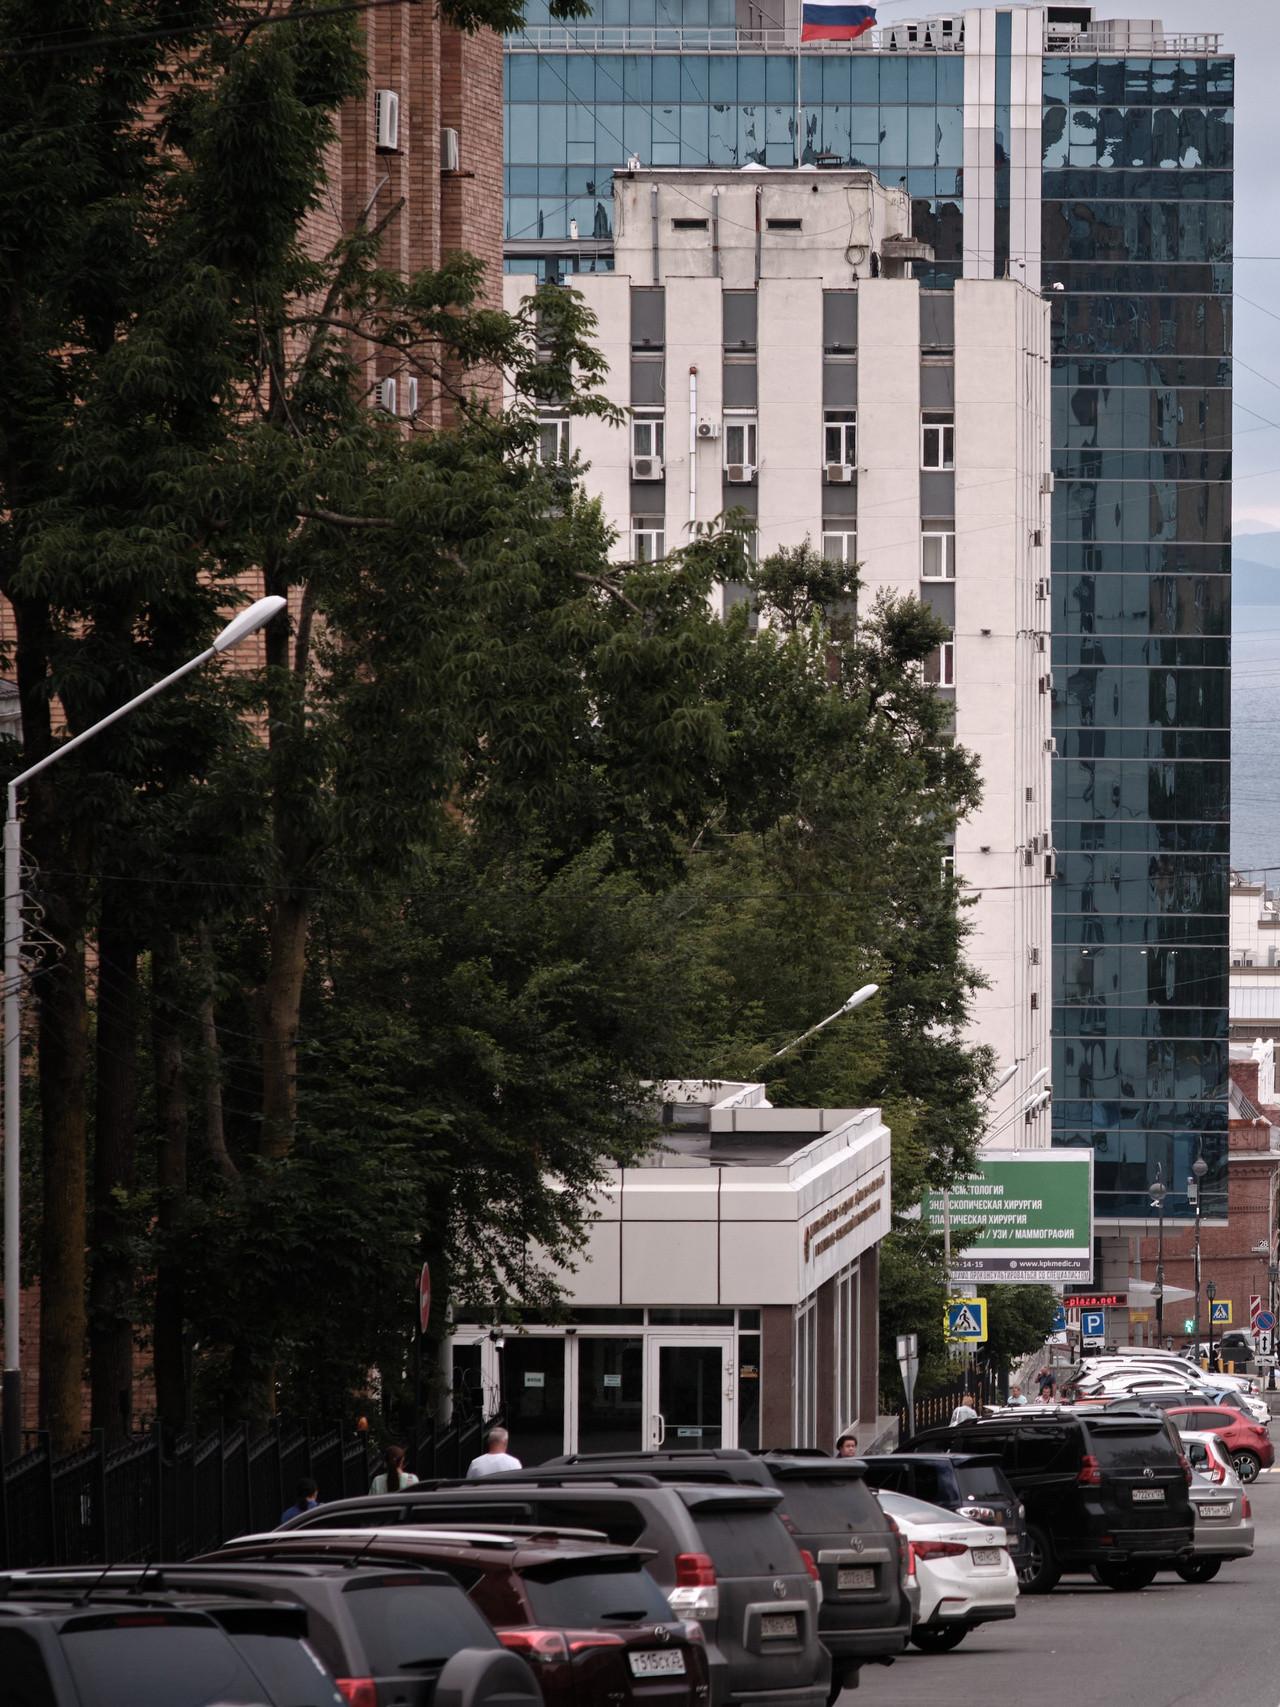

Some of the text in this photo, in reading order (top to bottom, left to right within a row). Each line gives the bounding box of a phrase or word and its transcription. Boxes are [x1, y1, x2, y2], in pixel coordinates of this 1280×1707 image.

[929, 1200, 1043, 1210] ЭНДСКОПИЧЕСКАЯ ХИРУРГИЯ
[929, 1215, 1027, 1225] ПЛАТИЧЕСКАЯ ХИРУРГИЯ
[992, 1229, 1008, 1239] УЗИ
[1015, 1229, 1075, 1239] МАММОГРАФИЯ
[1019, 1260, 1081, 1268] www.kpkmedic.ru
[970, 1271, 1037, 1280] ПРОКОНСУЛЬТИРОВАТЬСЯ
[1038, 1271, 1046, 1280] СО
[1046, 1271, 1089, 1280] СПЕЦИАЛИСТОМ
